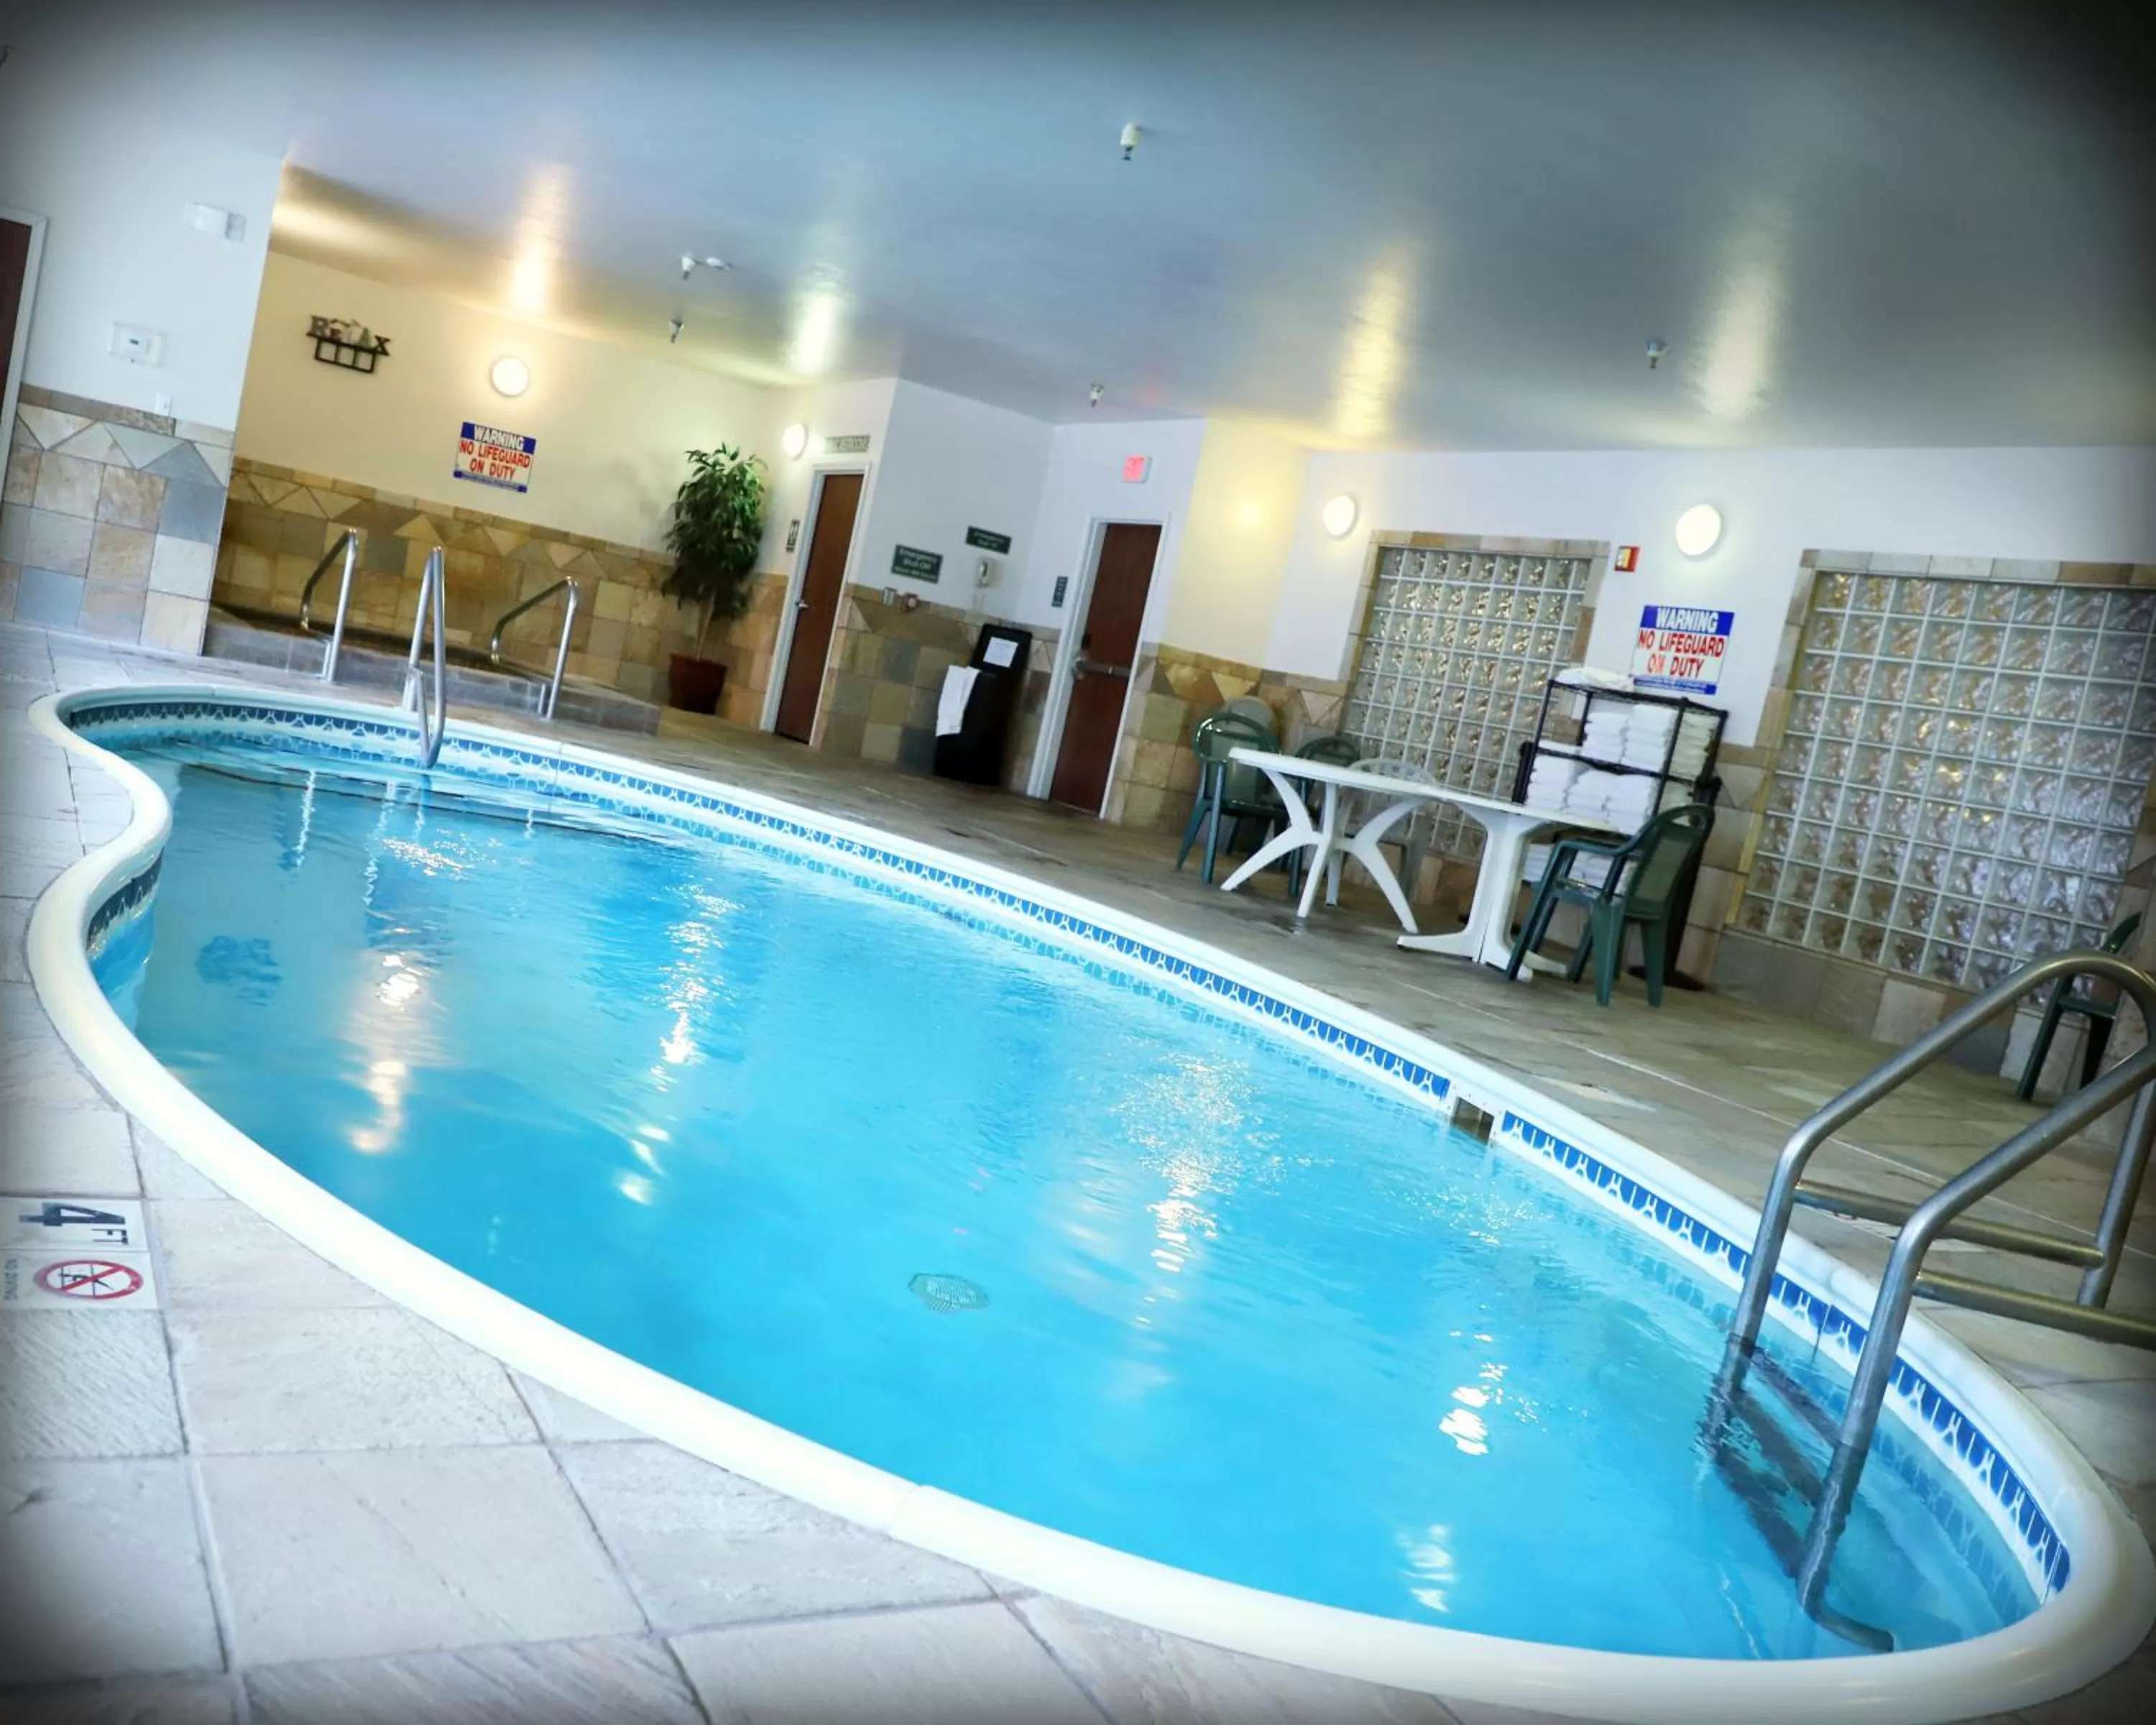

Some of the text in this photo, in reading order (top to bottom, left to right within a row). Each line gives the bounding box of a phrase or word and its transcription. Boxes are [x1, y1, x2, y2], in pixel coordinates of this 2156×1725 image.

[474, 425, 524, 450] WARNING
[459, 440, 530, 468] NO LIFEGUARD
[470, 459, 516, 480] ON DUTY
[1656, 607, 1719, 634] WARNING
[1639, 630, 1725, 658] NO LIFEGUARD
[1647, 653, 1704, 678] ON DUTY
[19, 1202, 129, 1245] 4 FT
